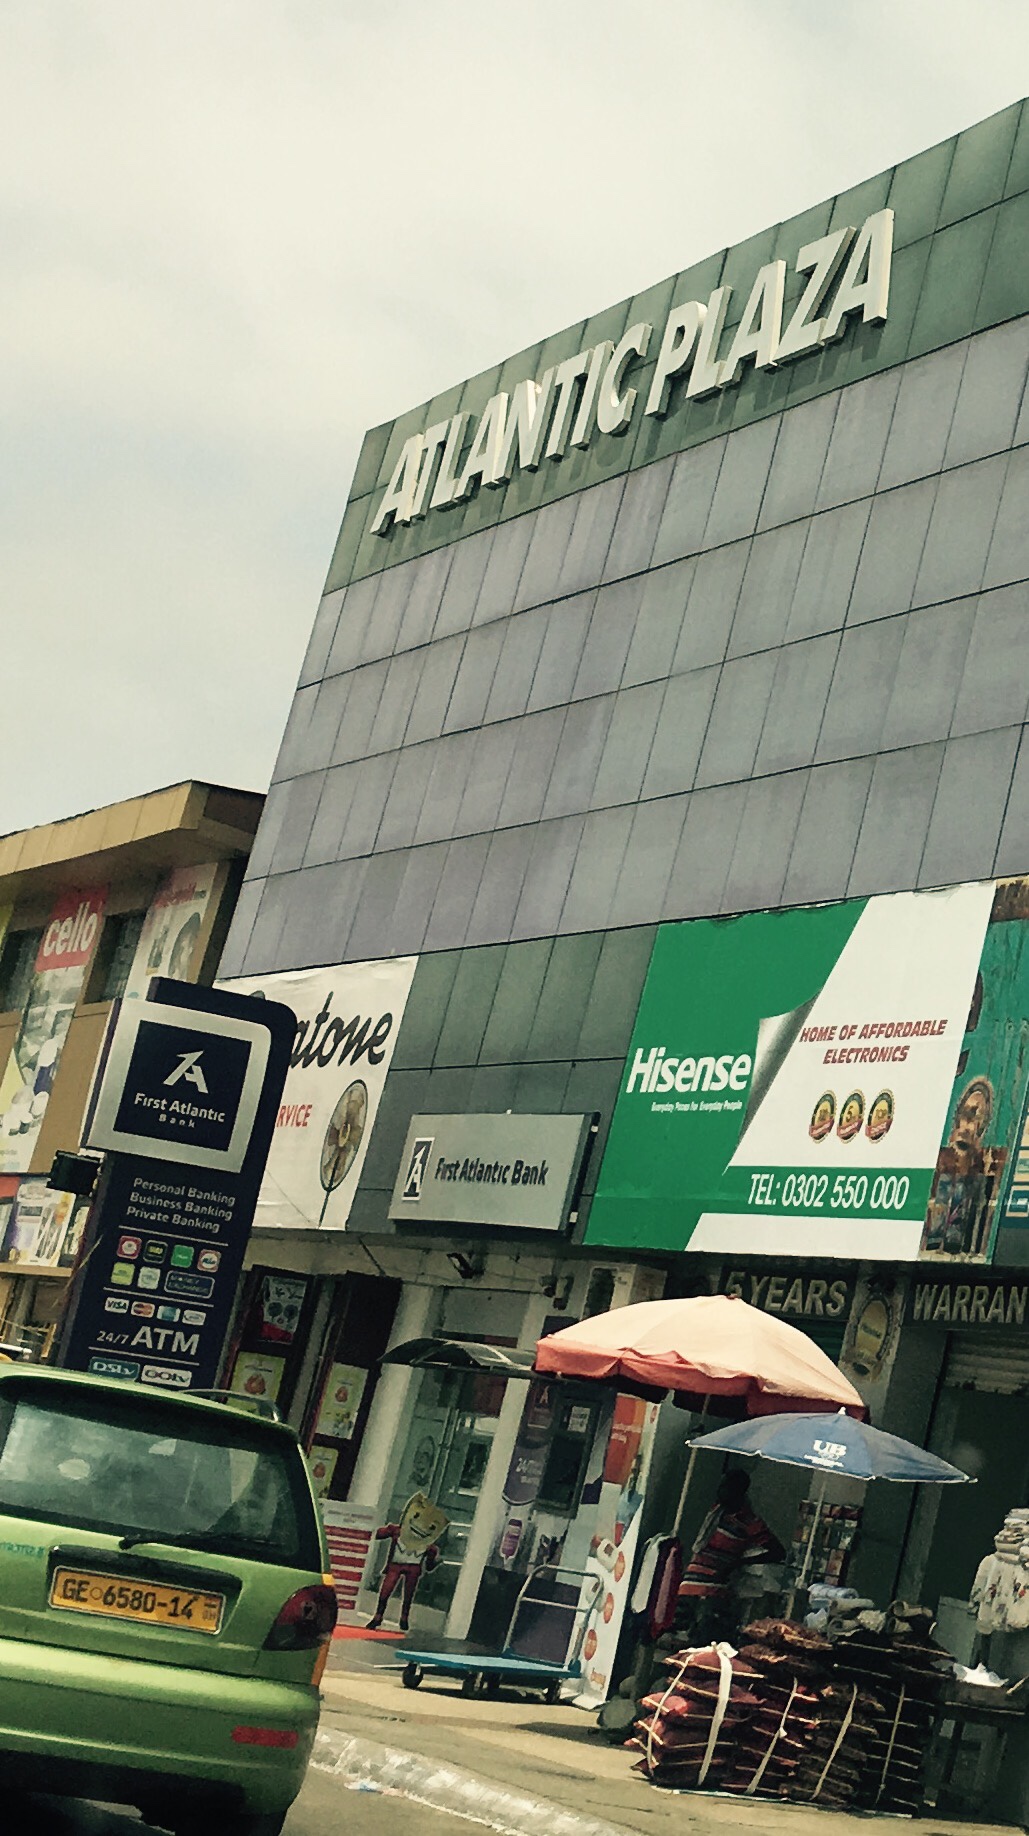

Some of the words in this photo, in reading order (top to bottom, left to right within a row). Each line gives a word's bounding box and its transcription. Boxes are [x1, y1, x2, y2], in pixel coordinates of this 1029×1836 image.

[370, 323, 652, 535] ATLANTIC
[645, 208, 894, 419] PLAZA
[43, 901, 98, 957] cello
[289, 991, 393, 1069] atone
[799, 1025, 838, 1043] HOME
[838, 1024, 858, 1041] OF
[858, 1019, 948, 1040] AFFORDABLE
[626, 1046, 751, 1093] Hisense
[823, 1045, 910, 1065] ELECTRONICS
[134, 1092, 168, 1111] First
[169, 1099, 226, 1123] Atlantic
[159, 1113, 196, 1129] Bank
[276, 1104, 313, 1128] RVICE
[434, 1157, 460, 1182] First
[459, 1157, 511, 1185] Atlantic
[511, 1159, 549, 1186] Bank
[130, 1191, 182, 1210] Business
[185, 1201, 233, 1222] Banking
[133, 1177, 186, 1196] Personal
[188, 1186, 236, 1207] Banking
[748, 1173, 780, 1206] TEL:
[781, 1173, 828, 1208] 0302
[830, 1175, 868, 1210] 550
[871, 1175, 910, 1210] 000
[126, 1206, 170, 1223] Private
[172, 1214, 220, 1234] Banking
[107, 1300, 127, 1311] VISA
[750, 1276, 848, 1317] YEARS
[913, 1284, 1029, 1325] WARRAN
[96, 1330, 129, 1345] 24/7
[131, 1325, 200, 1356] ATM
[62, 1577, 90, 1604] GE
[102, 1584, 198, 1620] 6580-14
